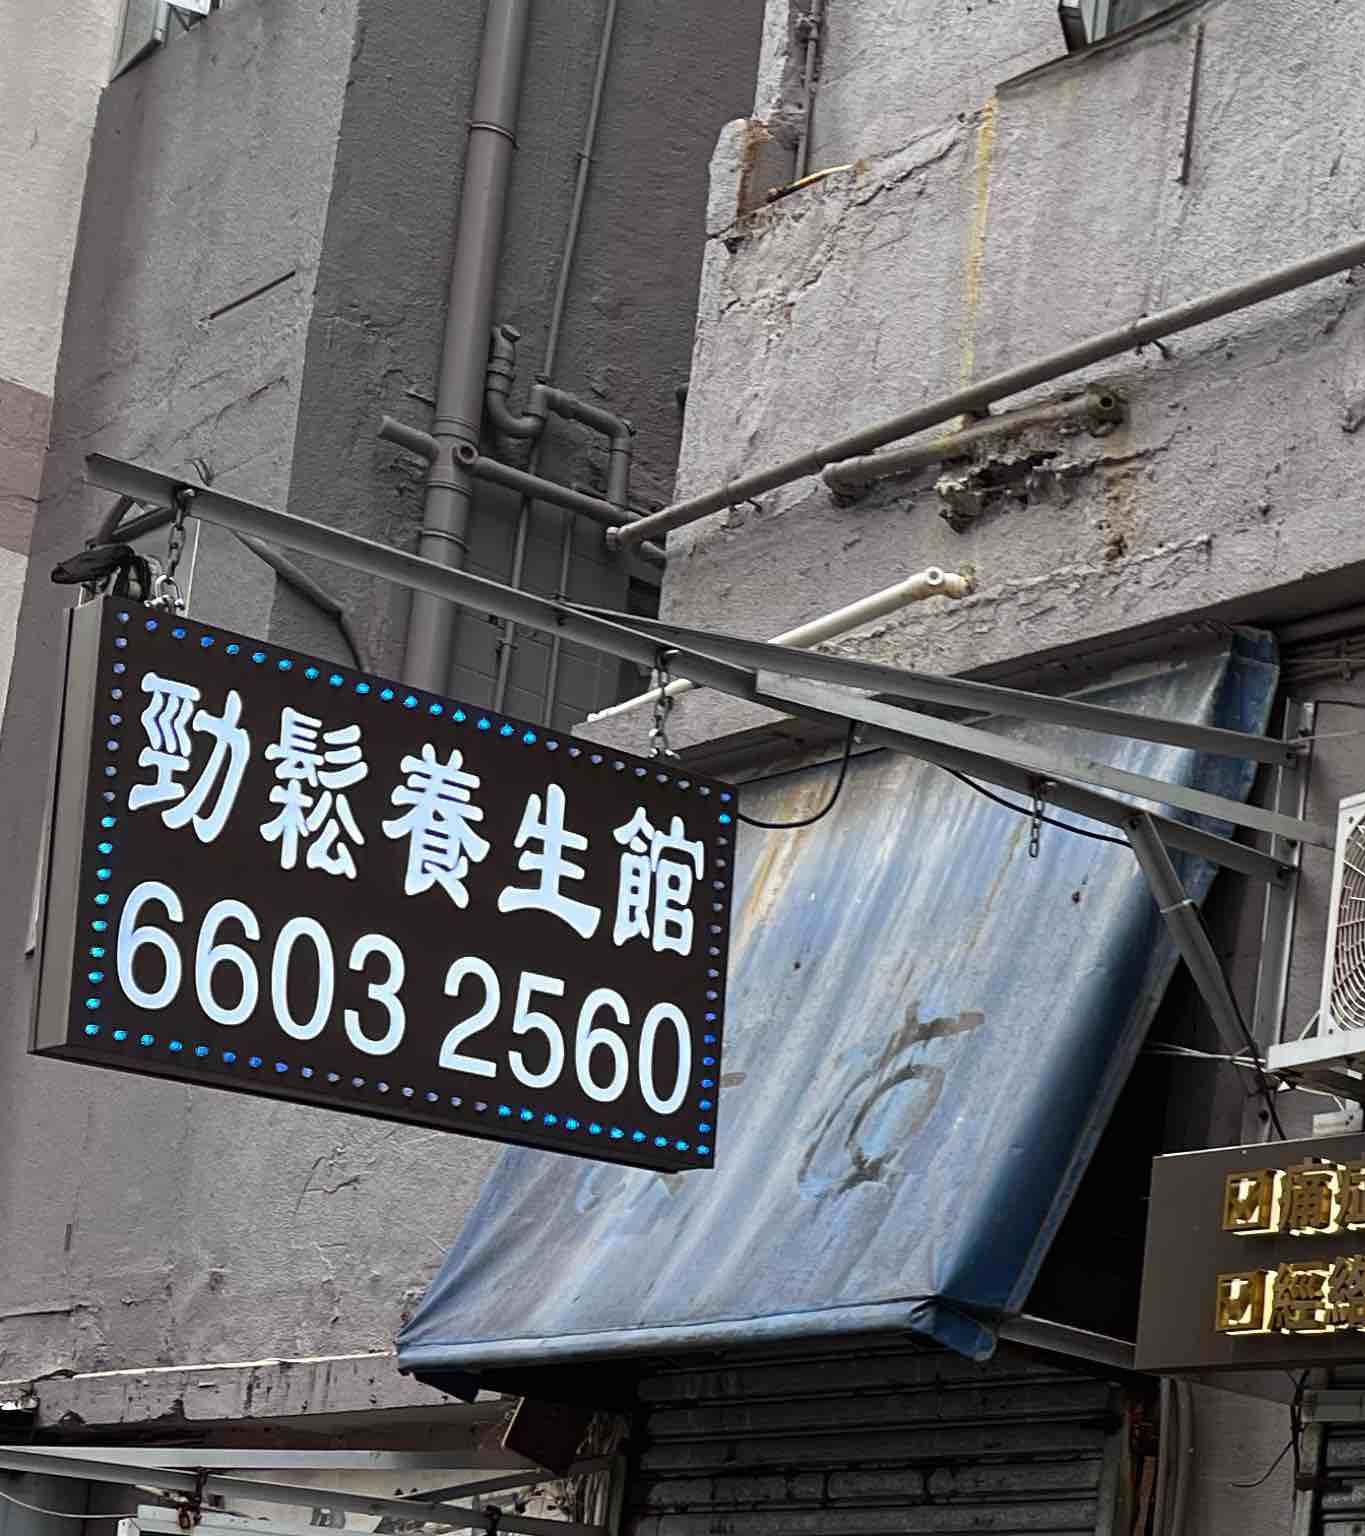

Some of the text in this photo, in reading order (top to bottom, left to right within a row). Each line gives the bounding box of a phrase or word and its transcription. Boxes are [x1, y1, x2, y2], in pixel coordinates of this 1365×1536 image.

[127, 671, 705, 957] 勁鬆養生館
[116, 880, 692, 1115] 6603 2560
